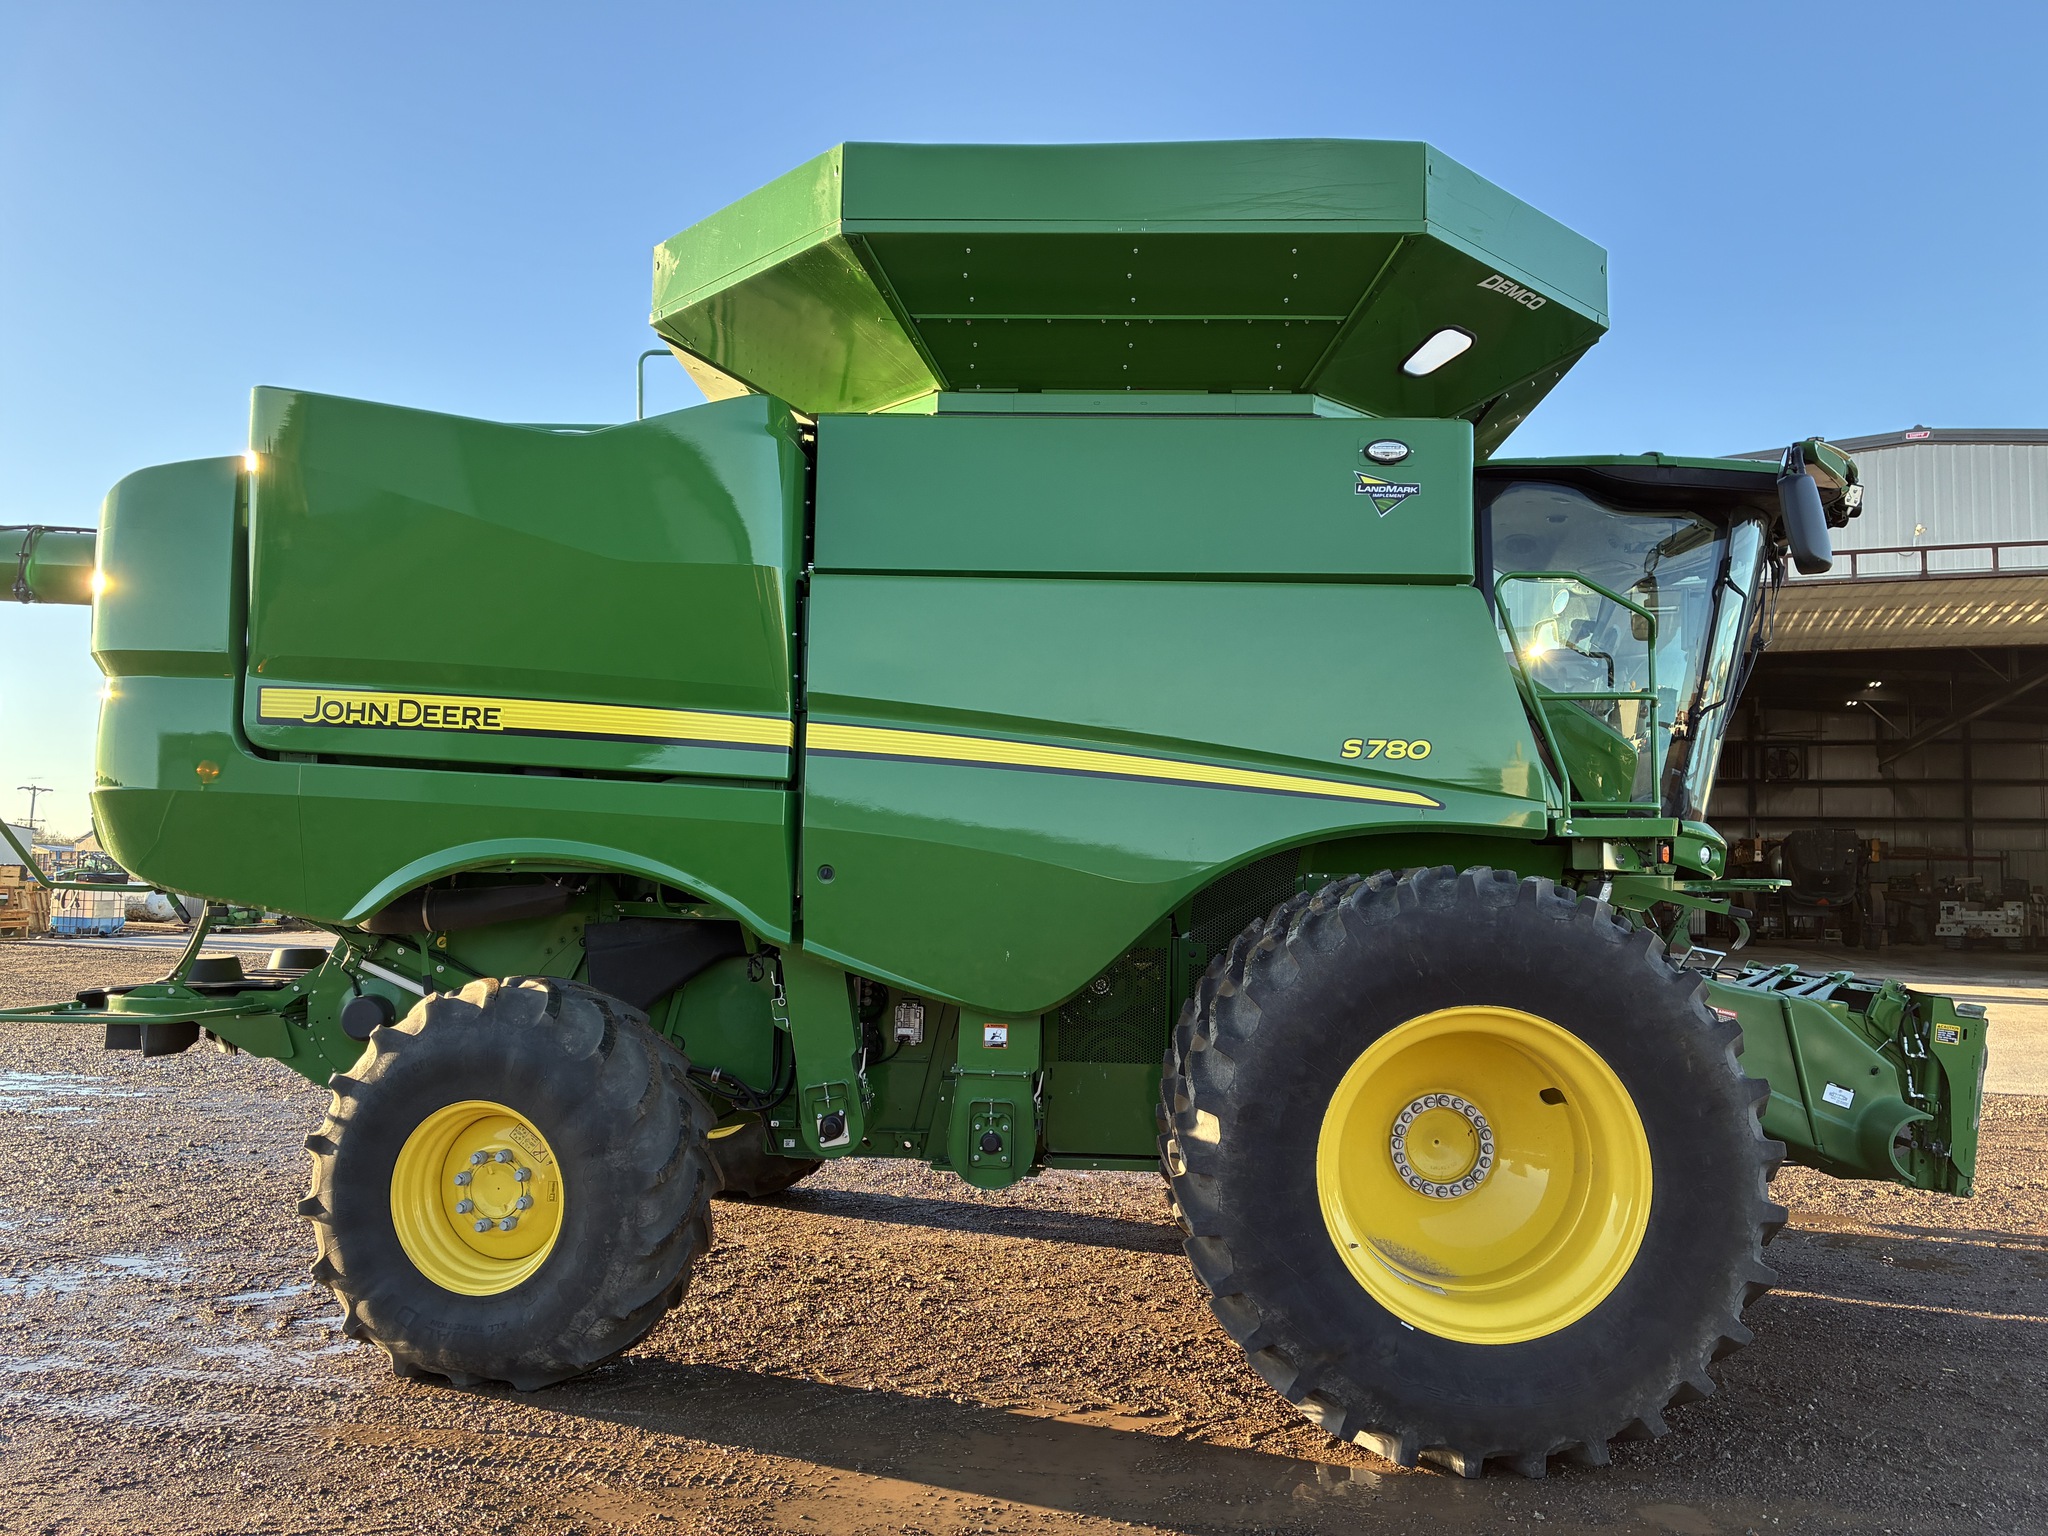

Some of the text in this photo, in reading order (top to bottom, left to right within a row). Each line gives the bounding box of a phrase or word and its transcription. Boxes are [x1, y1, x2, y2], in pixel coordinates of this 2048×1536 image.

[1476, 274, 1547, 311] DEMCO
[303, 695, 502, 728] JOHN DEERE
[1340, 738, 1432, 761] S780
